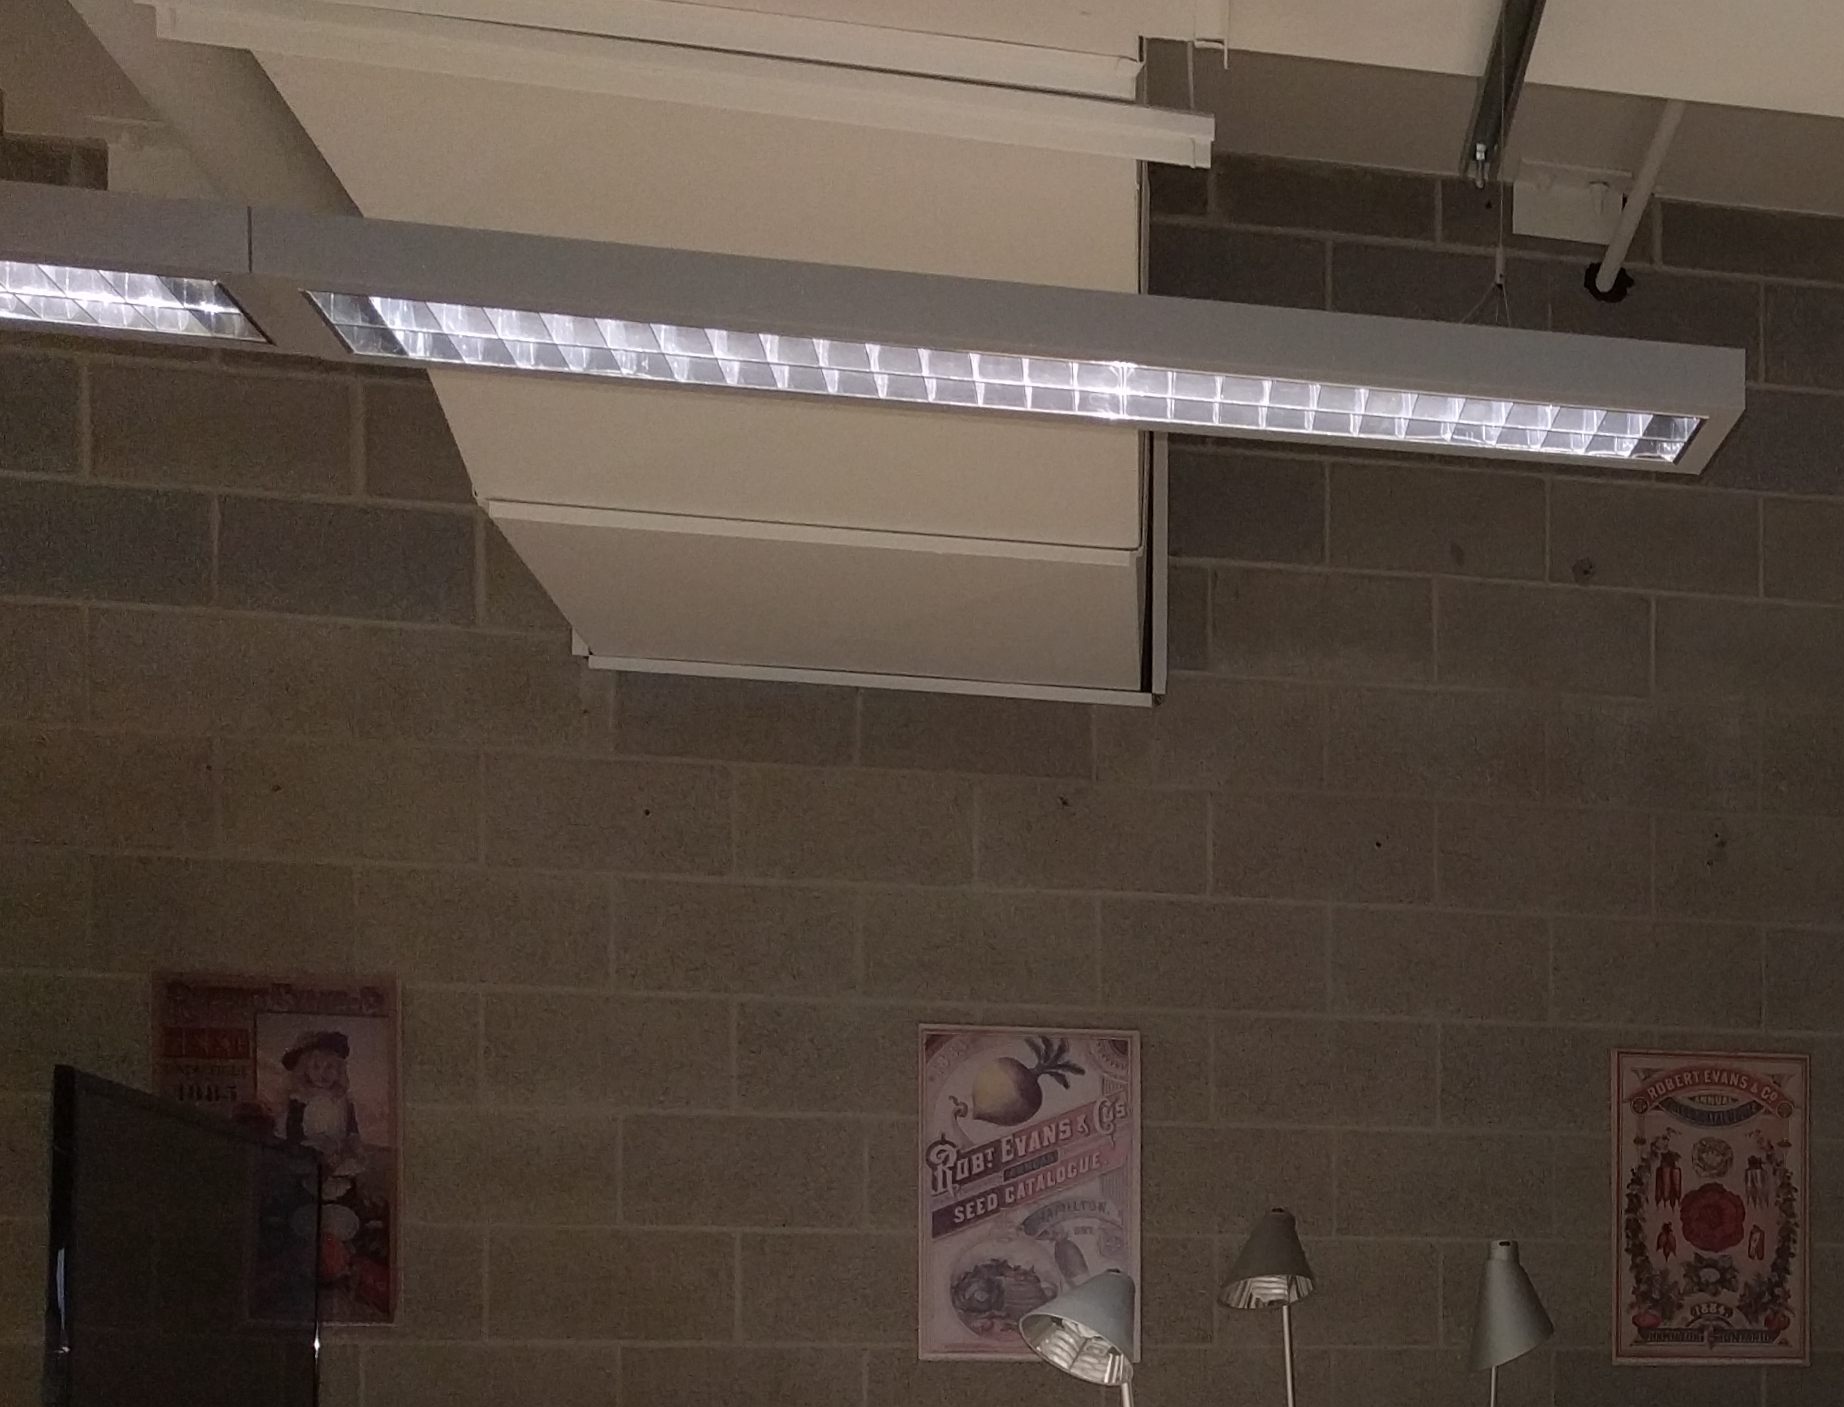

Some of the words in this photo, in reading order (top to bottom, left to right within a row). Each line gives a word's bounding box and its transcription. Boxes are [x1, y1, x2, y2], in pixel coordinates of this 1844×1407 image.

[1647, 1070, 1699, 1100] ROBERT
[1705, 1069, 1748, 1090] EVANS
[1750, 1084, 1758, 1094] &
[1001, 1118, 1072, 1163] EVANS
[1077, 1115, 1090, 1136] &
[953, 1193, 998, 1223] SEED
